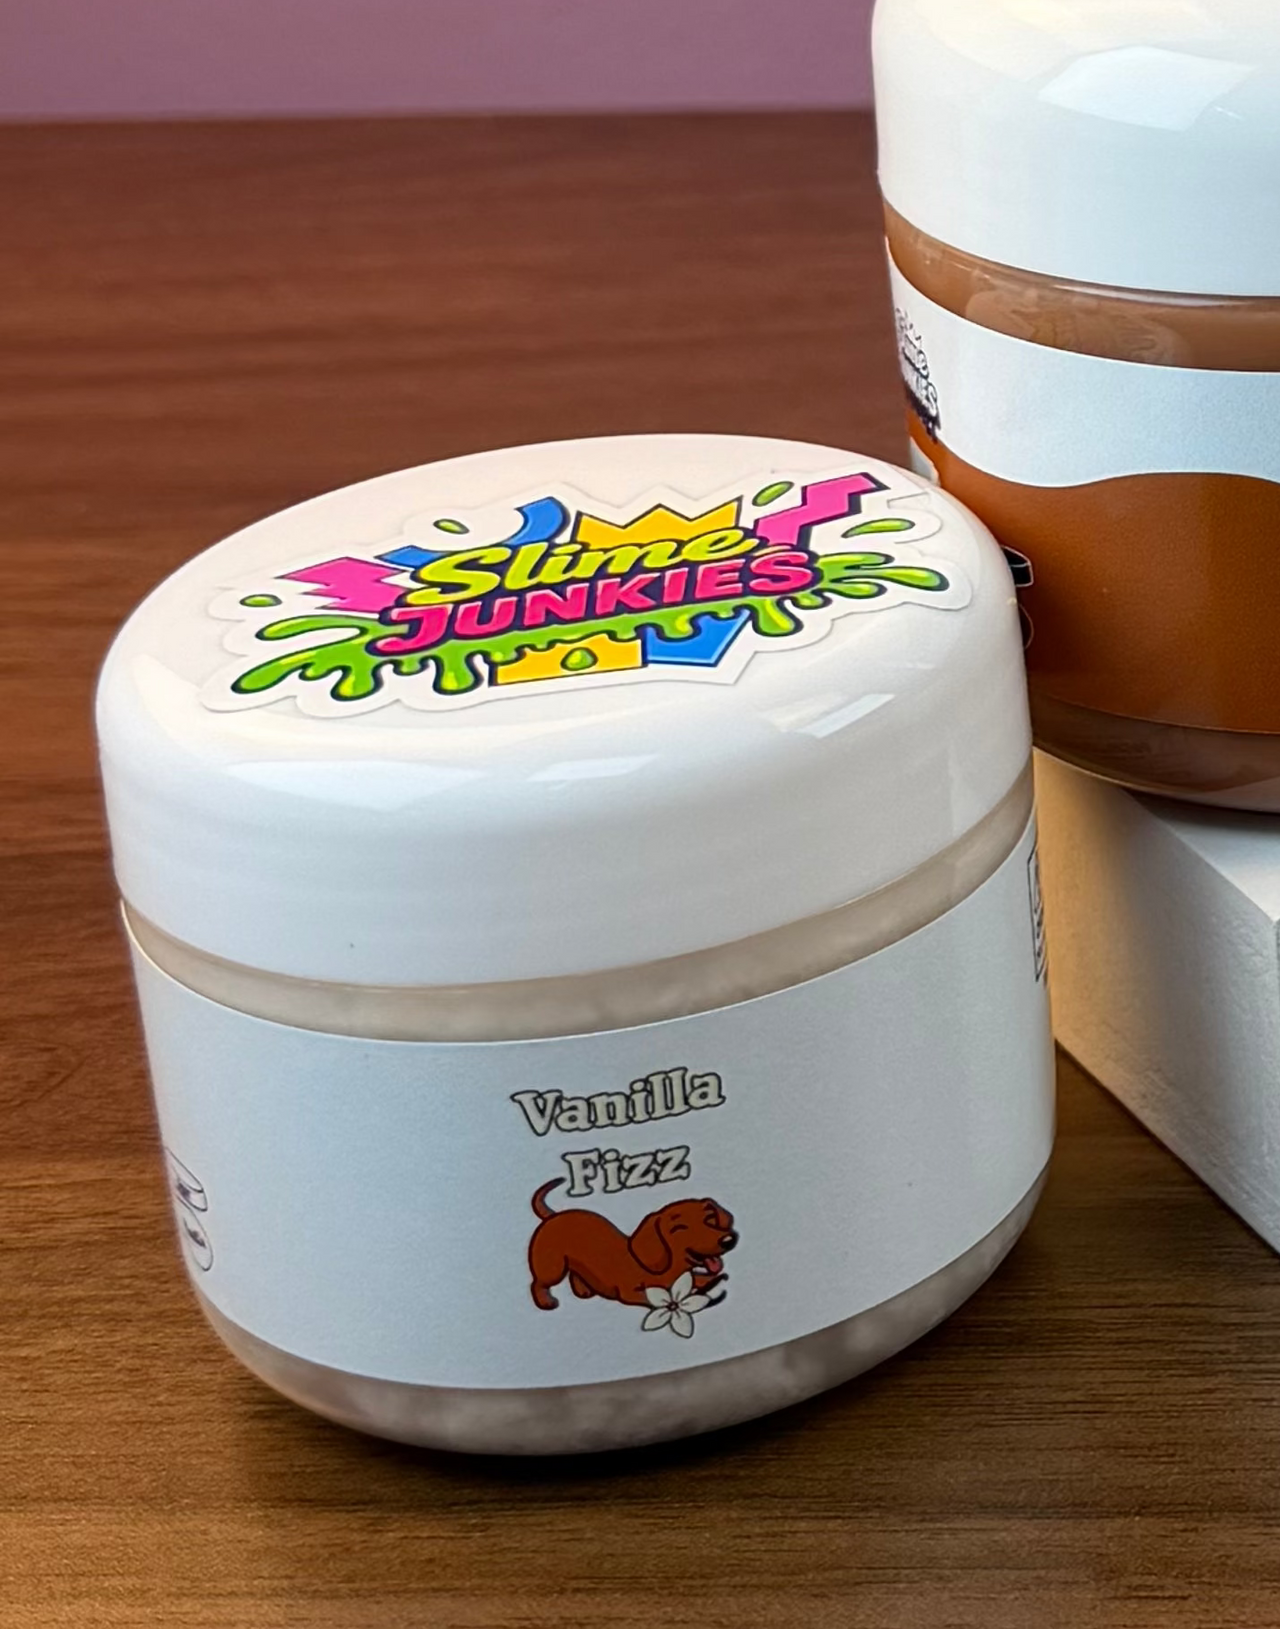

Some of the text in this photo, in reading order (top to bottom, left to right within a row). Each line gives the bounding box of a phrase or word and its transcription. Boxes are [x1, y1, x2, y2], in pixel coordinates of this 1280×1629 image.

[368, 551, 815, 656] JUNKIES
[406, 526, 760, 608] Slime
[510, 1067, 727, 1137] Vanilla
[561, 1145, 691, 1198] Fizz
